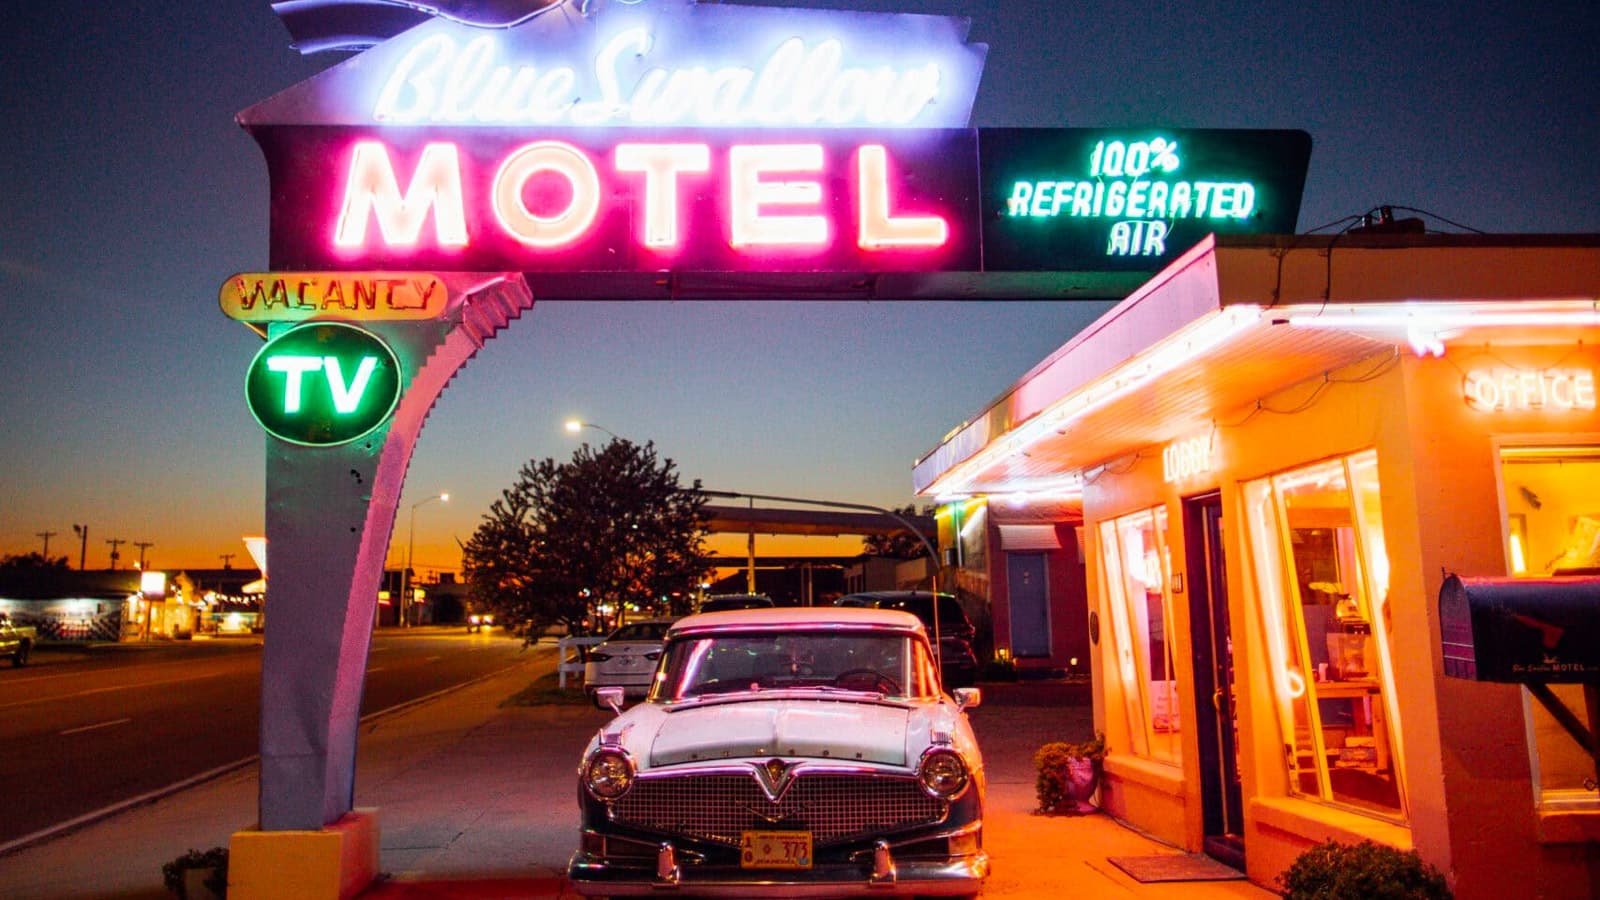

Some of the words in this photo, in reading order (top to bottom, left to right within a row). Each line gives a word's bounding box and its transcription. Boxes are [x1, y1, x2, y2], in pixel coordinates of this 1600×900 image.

[373, 33, 576, 124] Blue
[568, 27, 943, 125] Swallow
[1090, 136, 1180, 177] 100%
[334, 141, 949, 248] MOTEL
[1007, 180, 1256, 218] REFRIGERATED
[1106, 220, 1168, 256] AIR
[234, 278, 437, 311] VACANCY
[267, 356, 377, 414] TV
[1472, 369, 1597, 410] OFFICE
